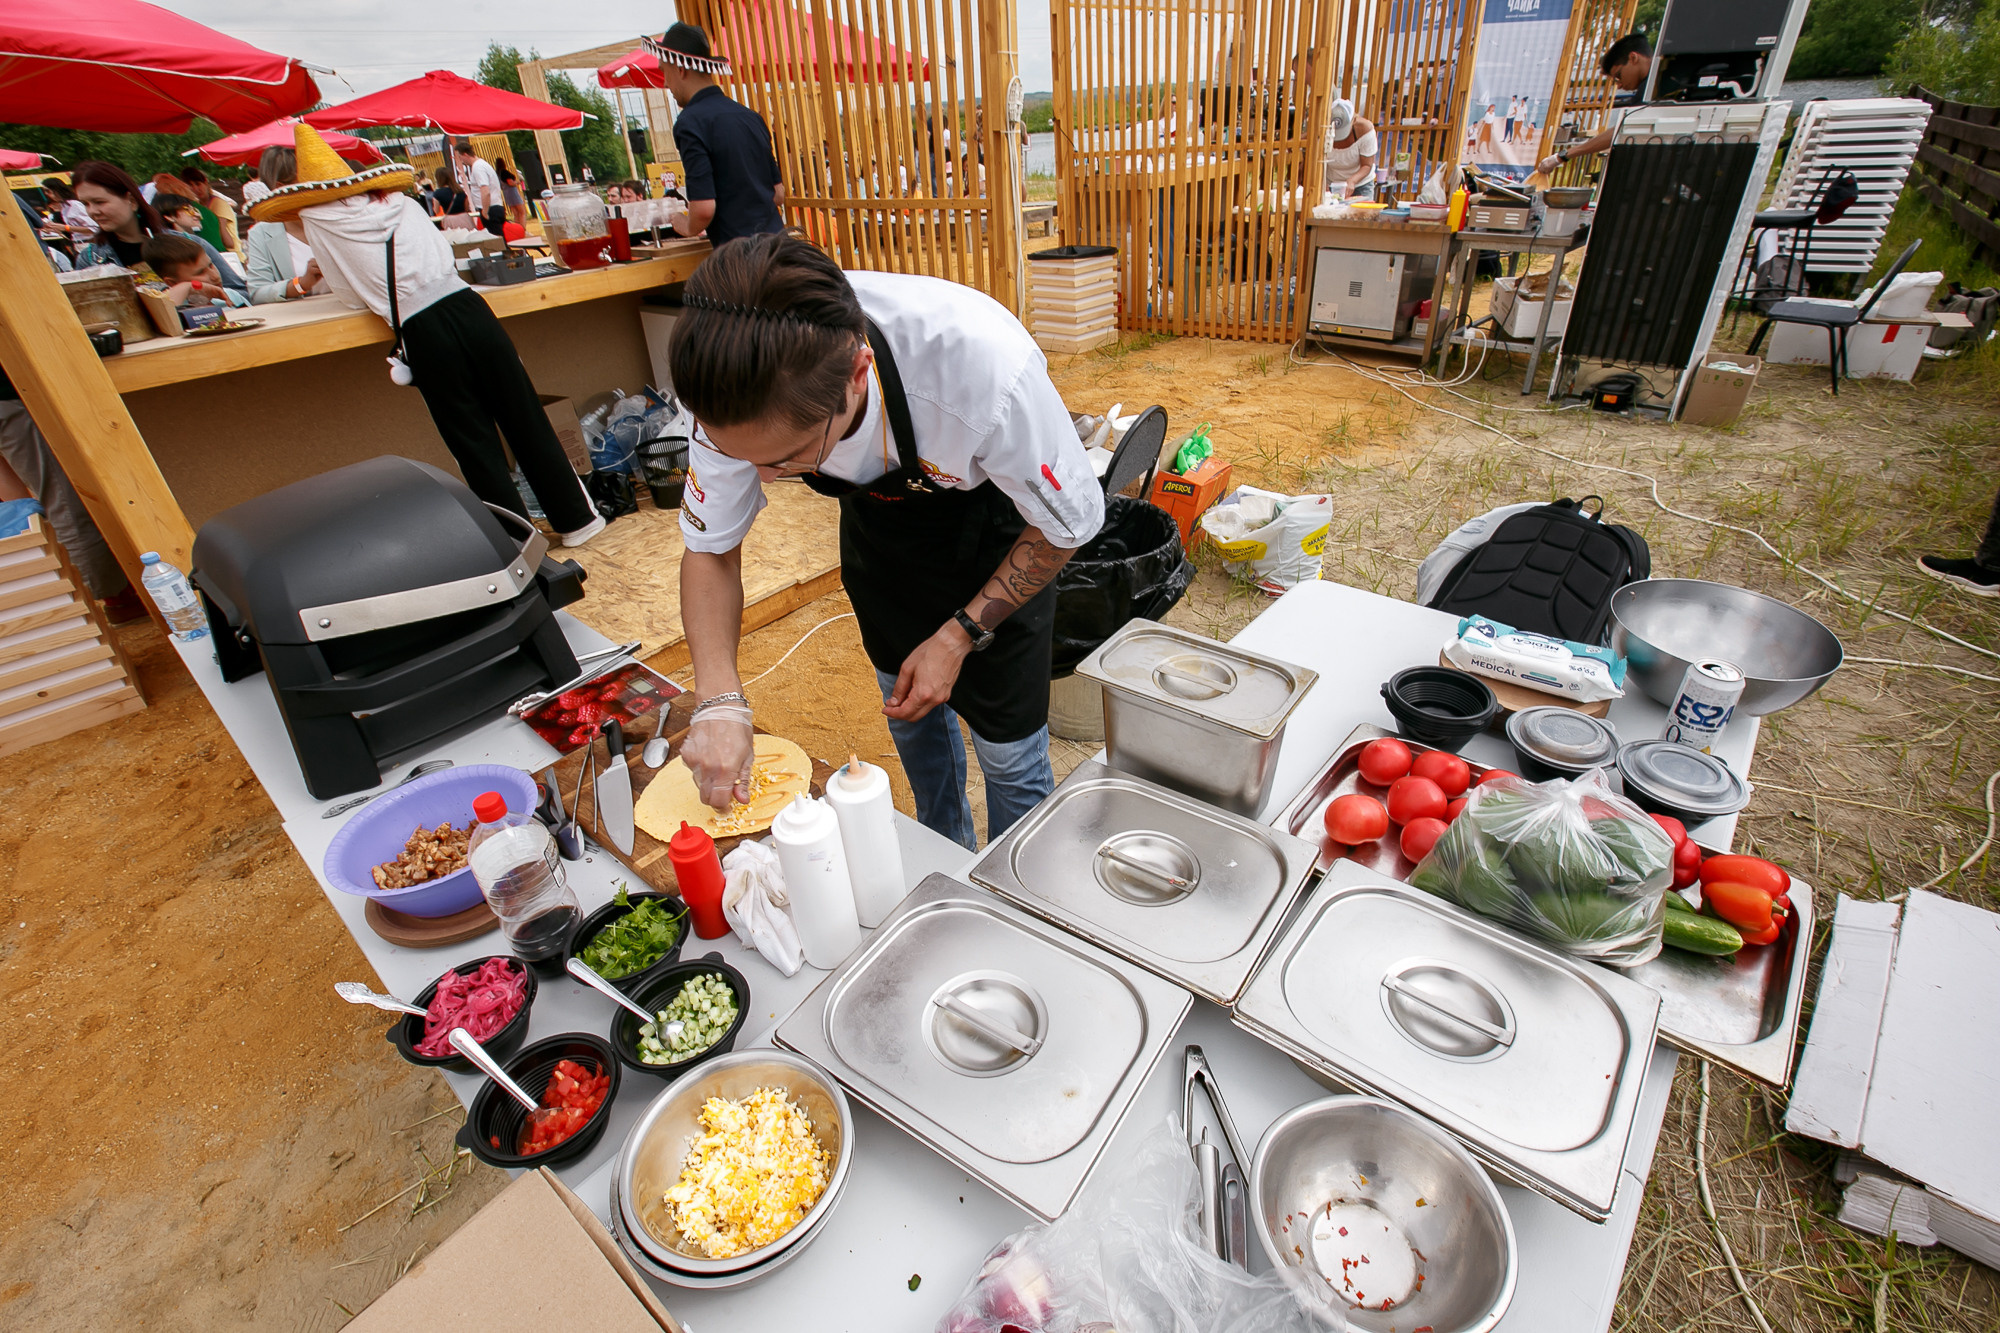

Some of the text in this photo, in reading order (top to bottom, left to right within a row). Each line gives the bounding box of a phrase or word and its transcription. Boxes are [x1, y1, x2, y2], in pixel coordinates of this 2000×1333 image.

[1163, 482, 1192, 495] APEROL
[1511, 637, 1560, 651] MEDICAL
[1472, 653, 1497, 664] smart
[1471, 659, 1517, 677] MEDICAL
[1674, 692, 1736, 729] ESSA
